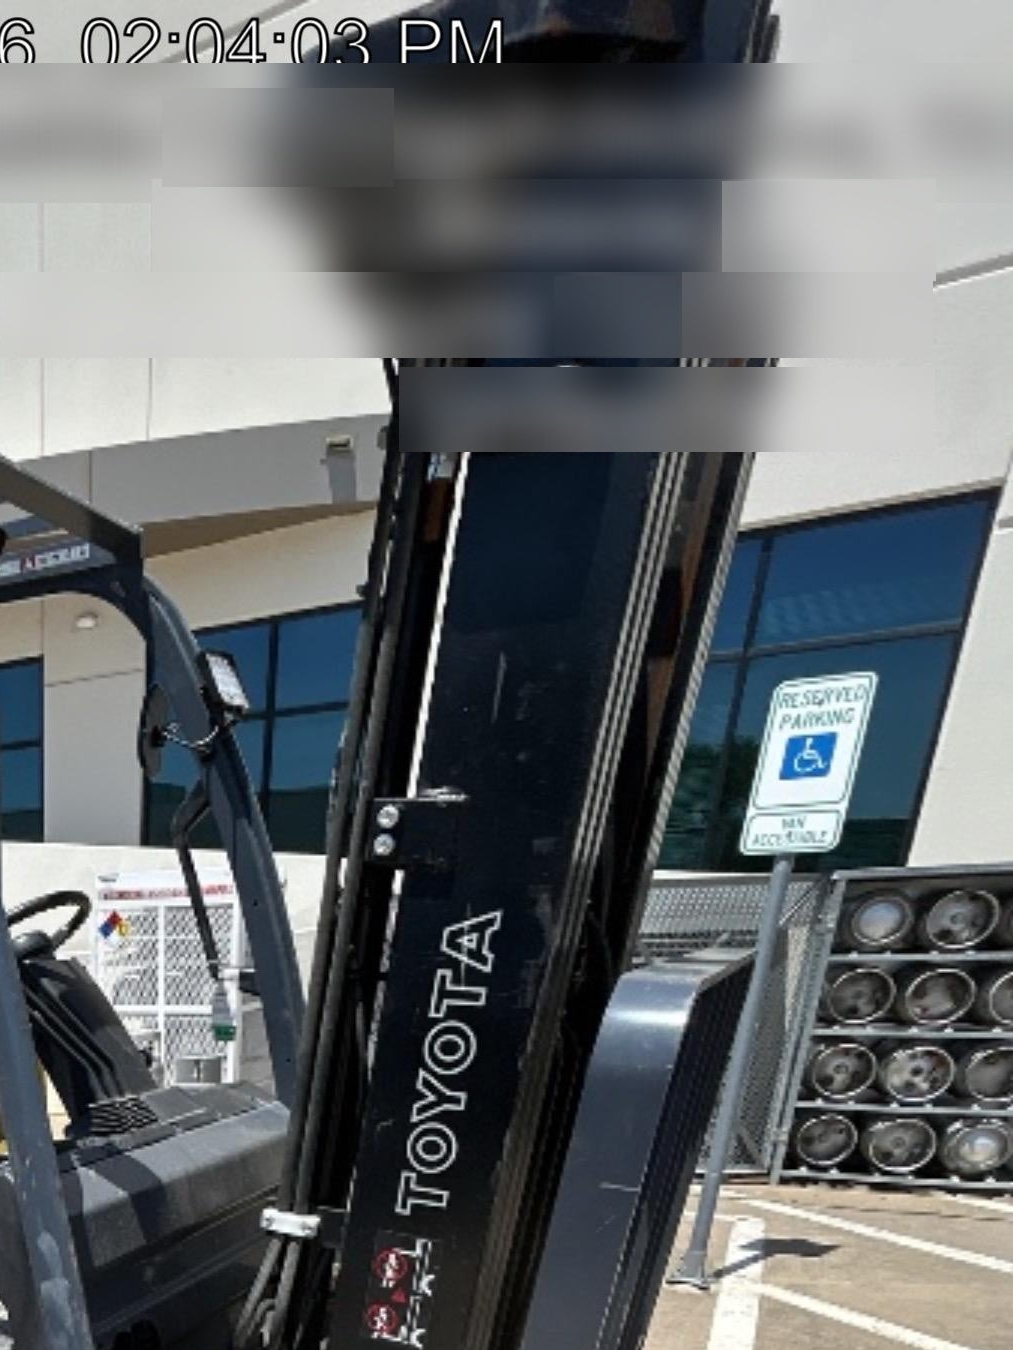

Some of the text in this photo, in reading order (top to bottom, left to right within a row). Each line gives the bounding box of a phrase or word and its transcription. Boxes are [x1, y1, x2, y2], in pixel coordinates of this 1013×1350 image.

[778, 683, 870, 709] RESERVED
[778, 707, 856, 731] PARKING
[394, 909, 504, 1216] TOYOTA
